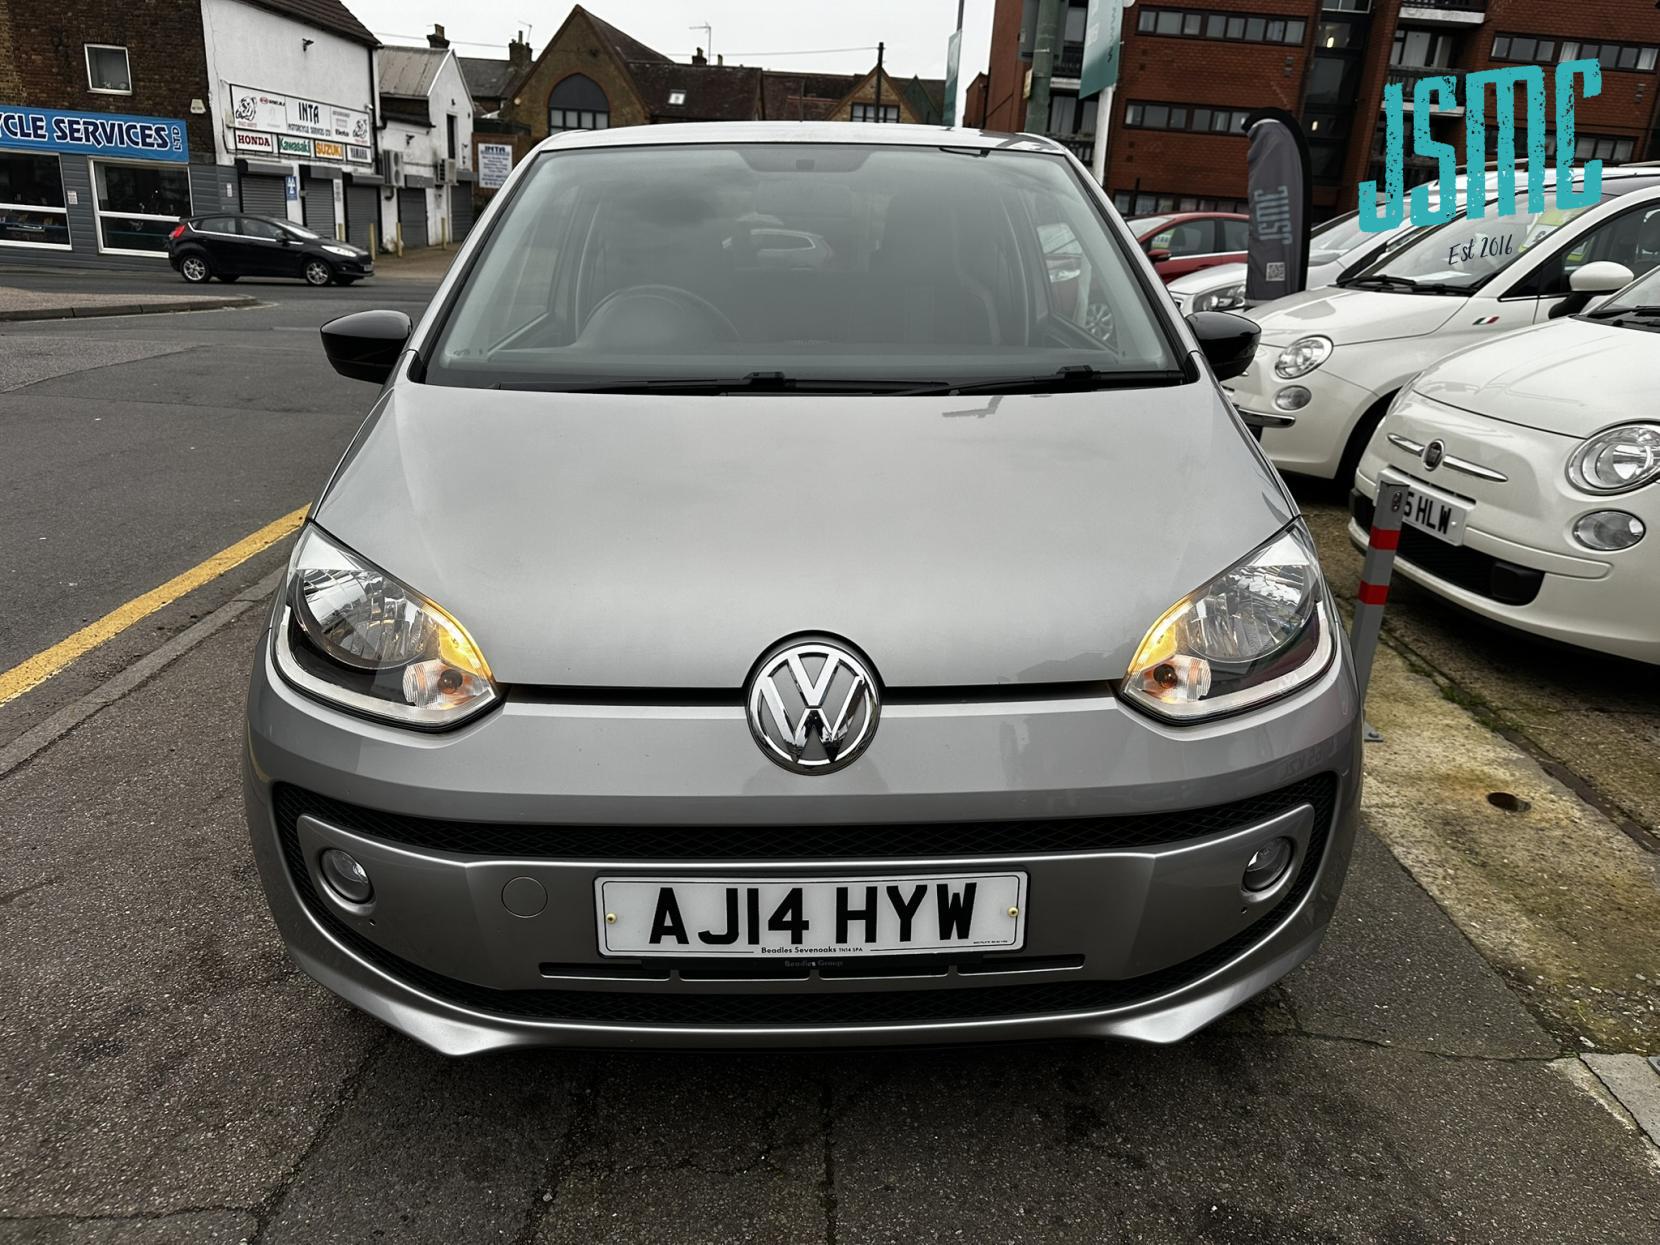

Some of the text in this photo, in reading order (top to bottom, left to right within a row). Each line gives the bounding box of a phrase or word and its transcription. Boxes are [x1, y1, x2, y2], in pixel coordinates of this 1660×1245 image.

[298, 102, 319, 124] INTA
[52, 117, 170, 150] SERVICES
[172, 126, 182, 151] LTD
[237, 134, 271, 147] HONDA
[280, 137, 311, 153] Kawasaki
[316, 142, 343, 156] SUZUKI
[1254, 185, 1292, 245] JSMC
[1416, 496, 1451, 534] HLW
[648, 881, 977, 945] AJ14 HYW
[761, 946, 792, 954] Beadles
